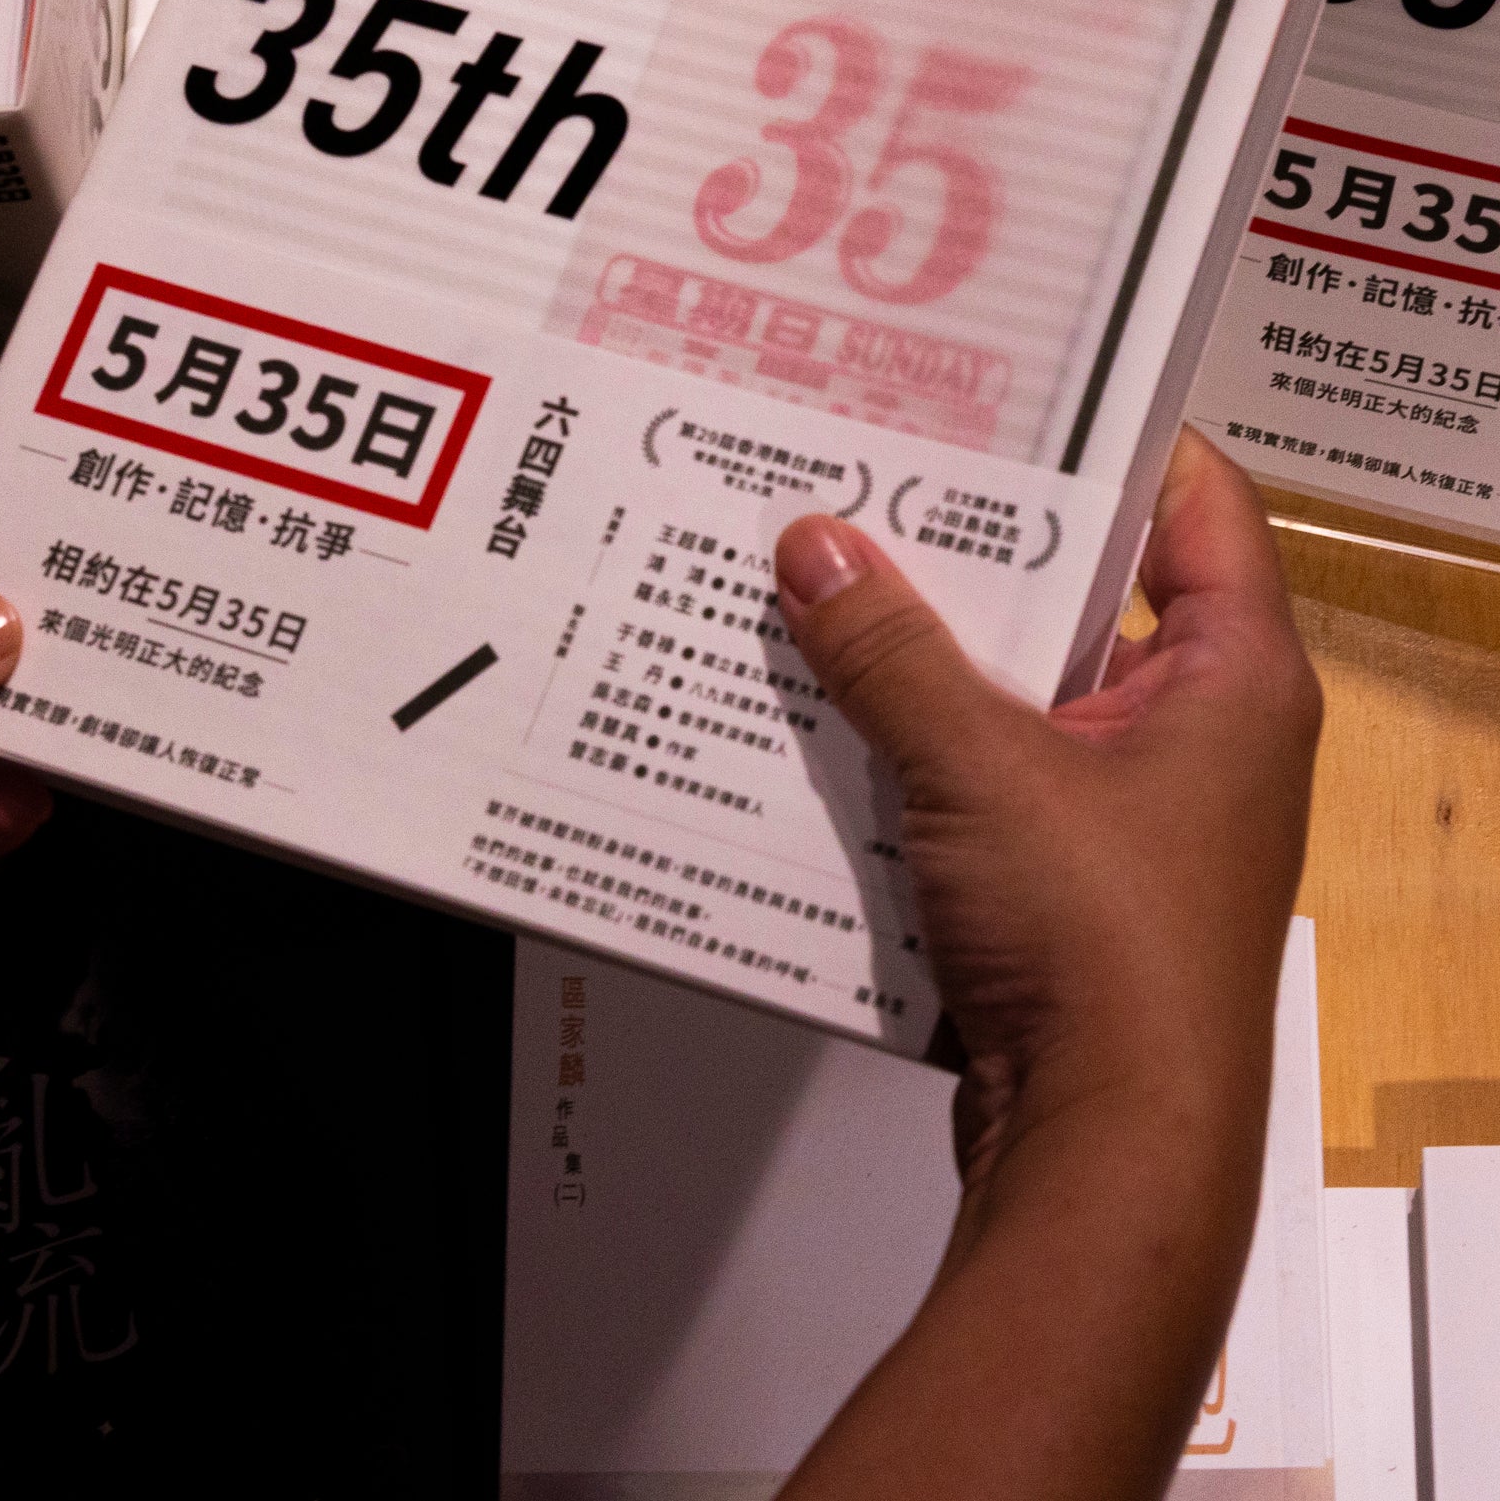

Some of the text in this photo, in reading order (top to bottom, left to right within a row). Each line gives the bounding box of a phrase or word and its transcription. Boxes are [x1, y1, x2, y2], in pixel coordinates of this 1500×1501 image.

[693, 16, 1040, 306] 35
[90, 314, 438, 480] 5月35日
[1269, 371, 1482, 436] 來個光明正大的紀念
[485, 395, 580, 560] 六四舞台
[38, 607, 267, 700] 來個光明正大的紀念
[40, 540, 309, 656] 相約在5月35日
[557, 975, 587, 1088] 區家麟
